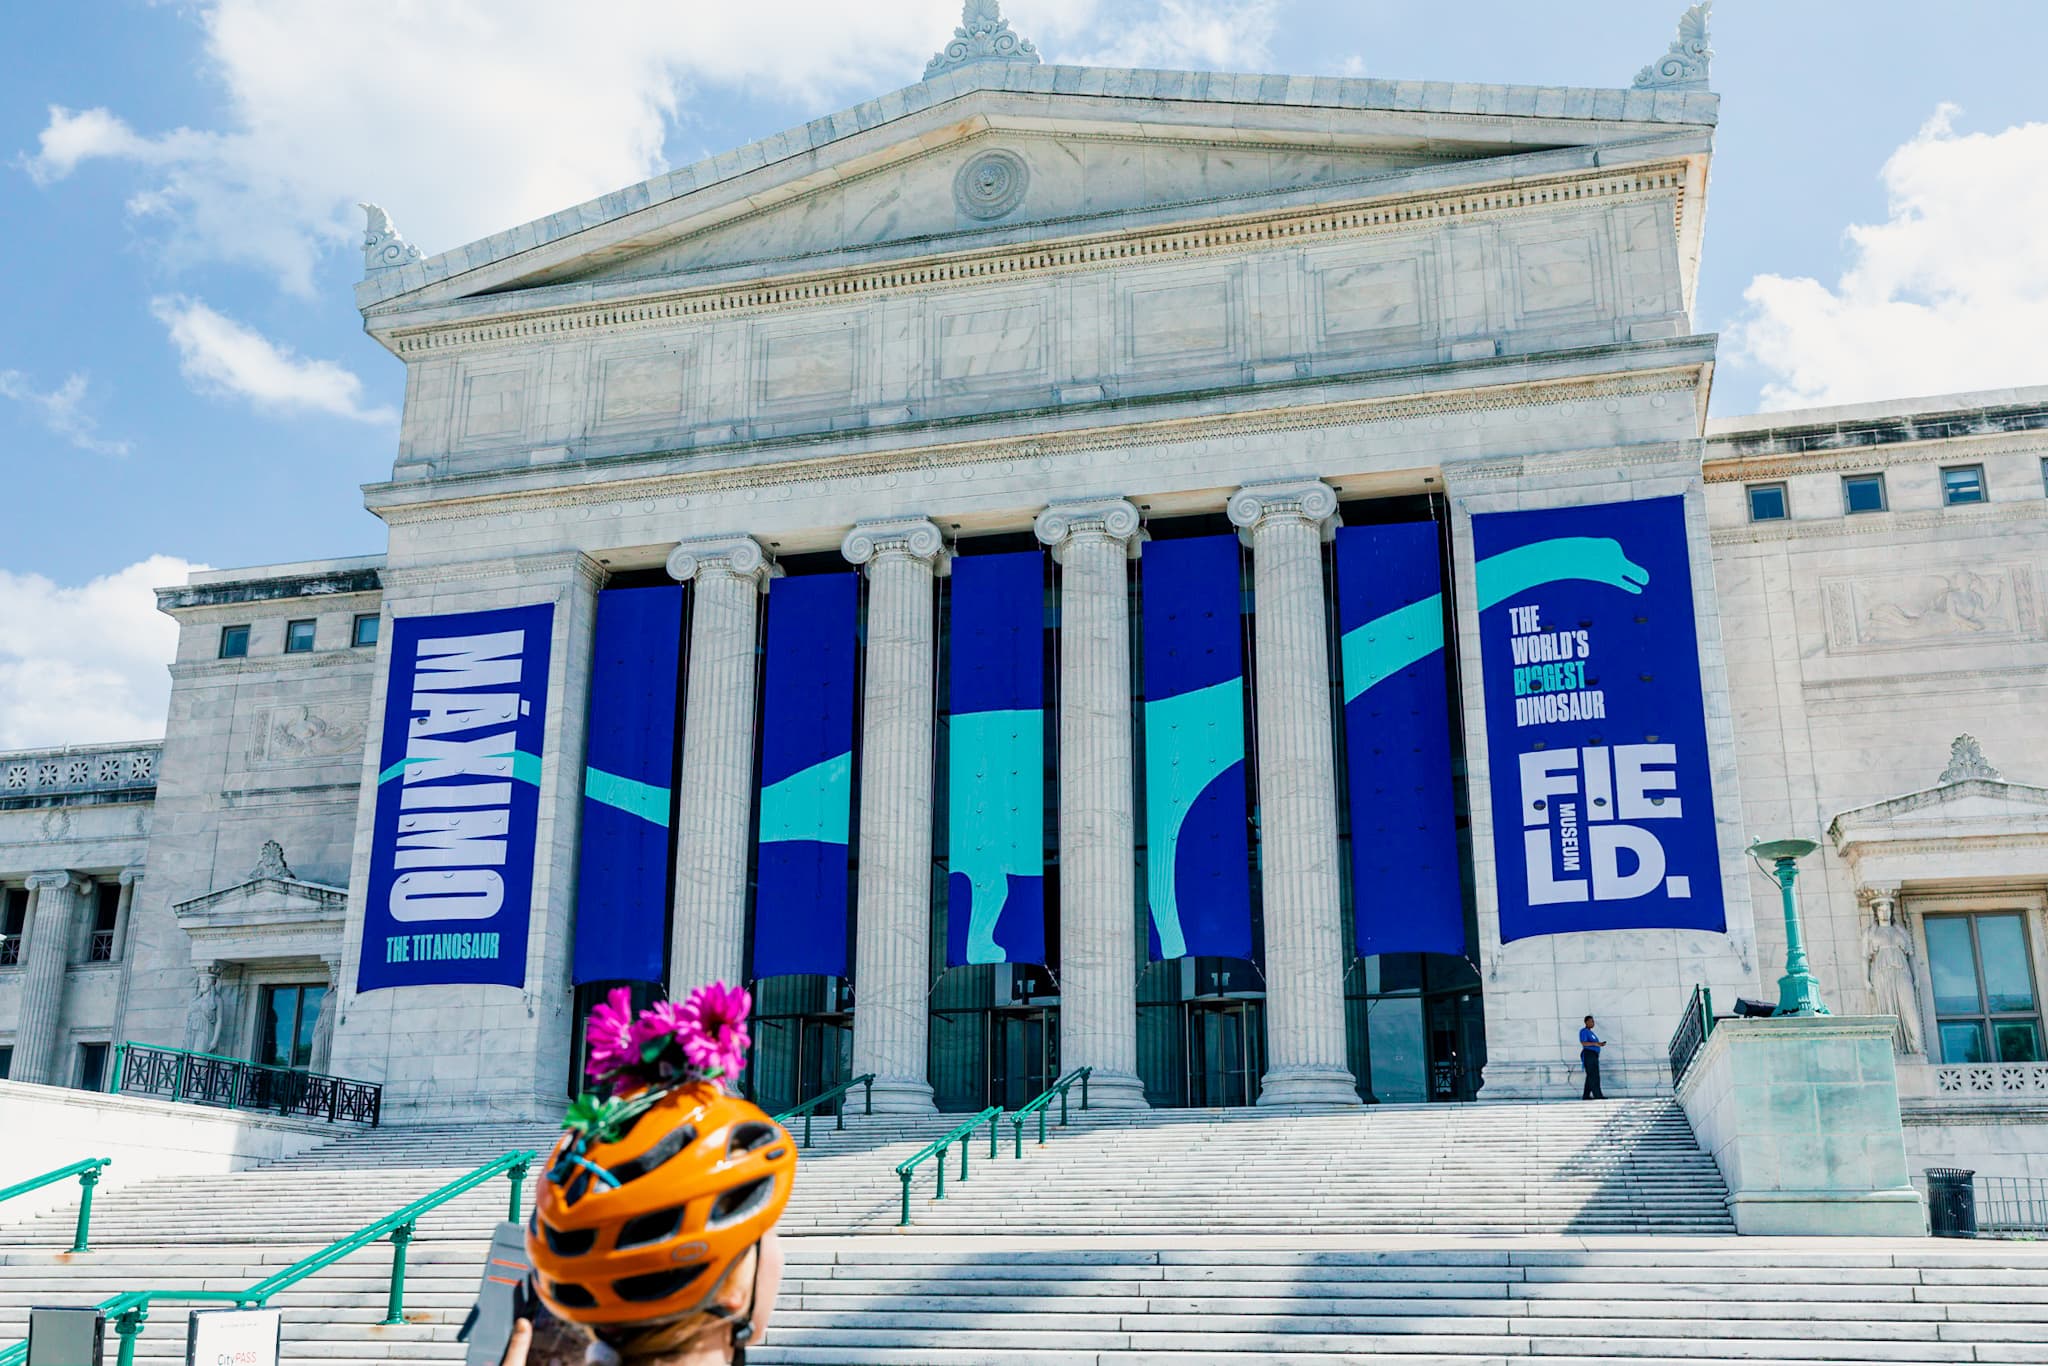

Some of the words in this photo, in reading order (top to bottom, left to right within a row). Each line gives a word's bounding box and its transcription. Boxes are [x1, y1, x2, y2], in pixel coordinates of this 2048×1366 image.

[1509, 605, 1541, 635] THE
[1511, 630, 1590, 666] WORLD'S
[1514, 661, 1586, 696] BIGGEST
[1516, 690, 1606, 727] DINOSAUR
[388, 630, 530, 922] MÁXIMO
[1559, 802, 1581, 871] MUSEUM
[386, 935, 410, 963] THE
[412, 932, 500, 961] TITANOSAUR
